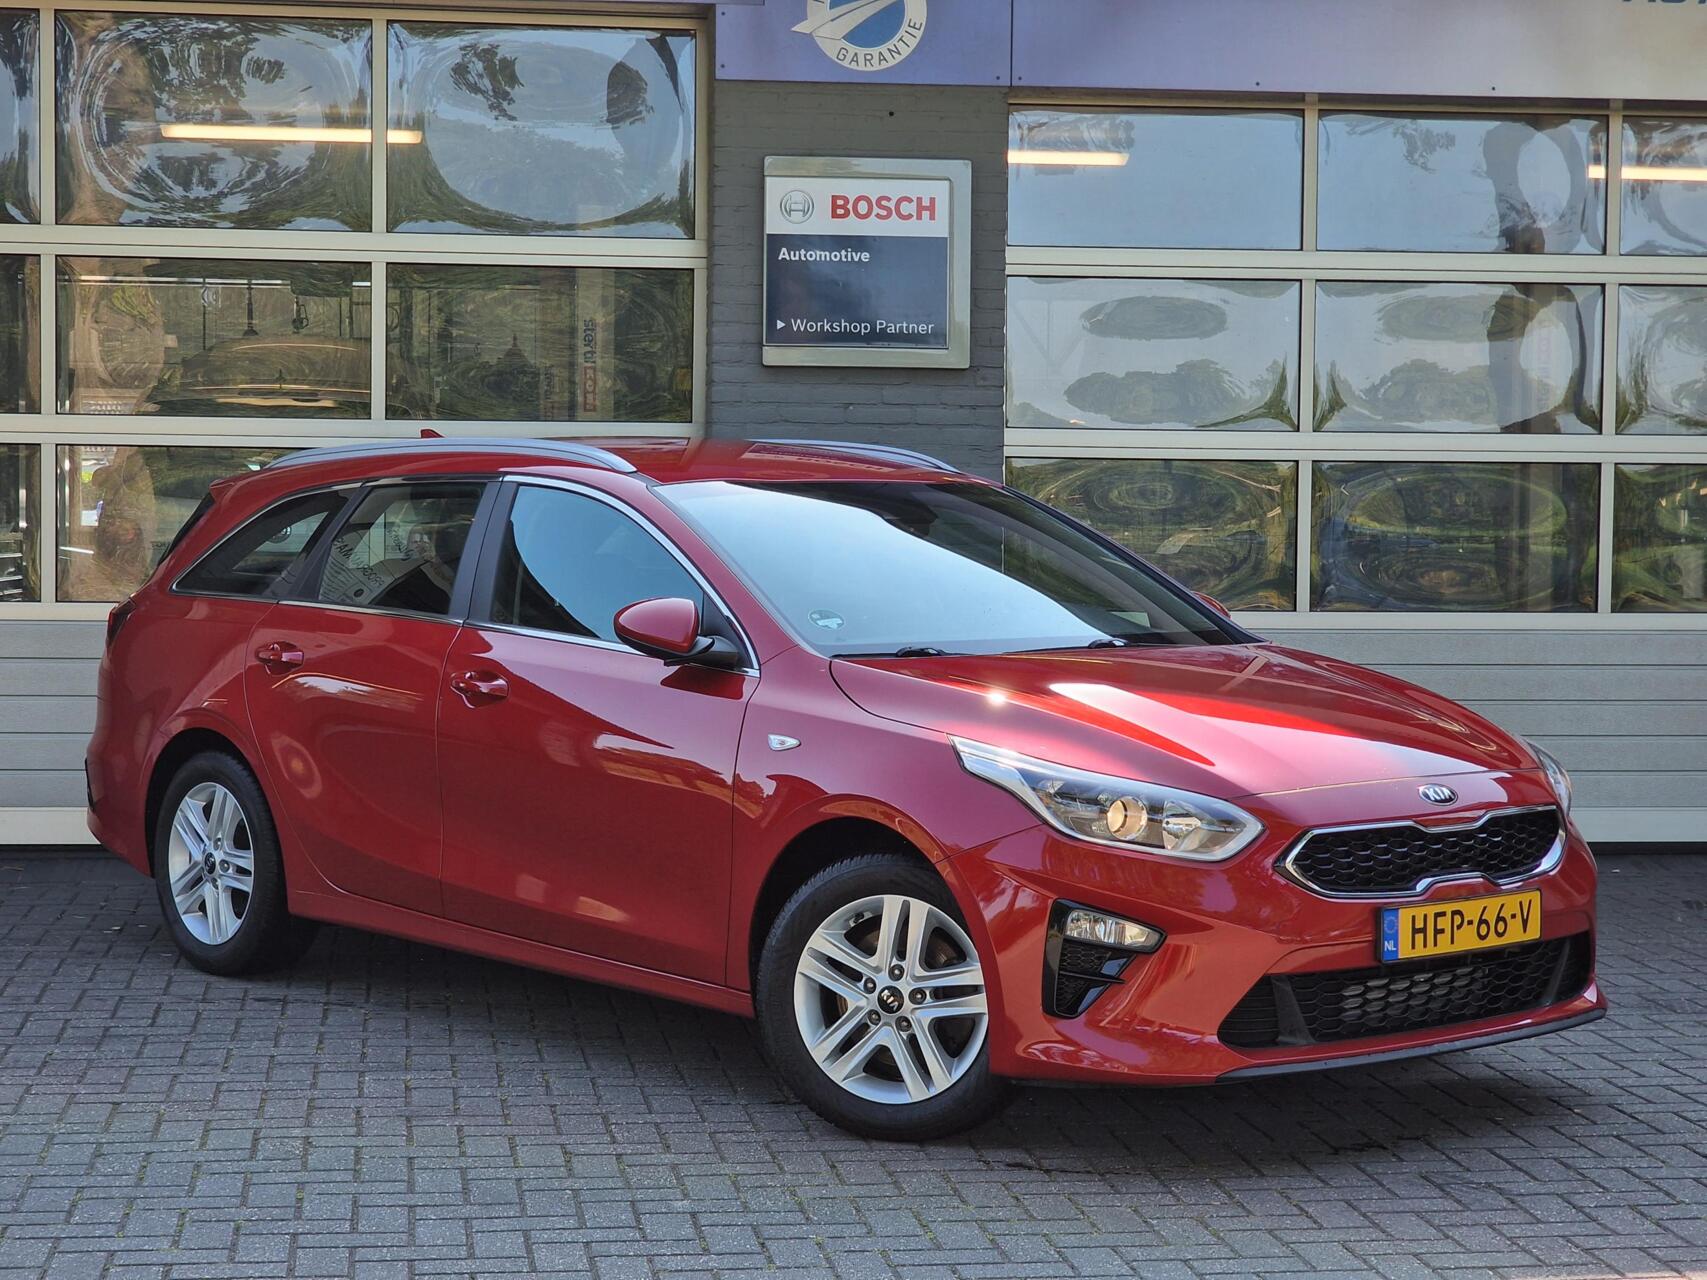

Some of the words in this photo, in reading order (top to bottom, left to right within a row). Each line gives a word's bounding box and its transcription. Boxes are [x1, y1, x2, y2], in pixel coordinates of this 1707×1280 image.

[836, 18, 923, 67] GARANTIE
[831, 194, 936, 221] BOSCH
[778, 247, 870, 262] Automotive
[791, 318, 871, 335] Workshop
[876, 320, 935, 334] Partner
[1425, 787, 1454, 800] KIA
[1411, 899, 1532, 950] HFP-66-V
[1384, 939, 1397, 951] NL
[881, 989, 899, 1011] KIA
